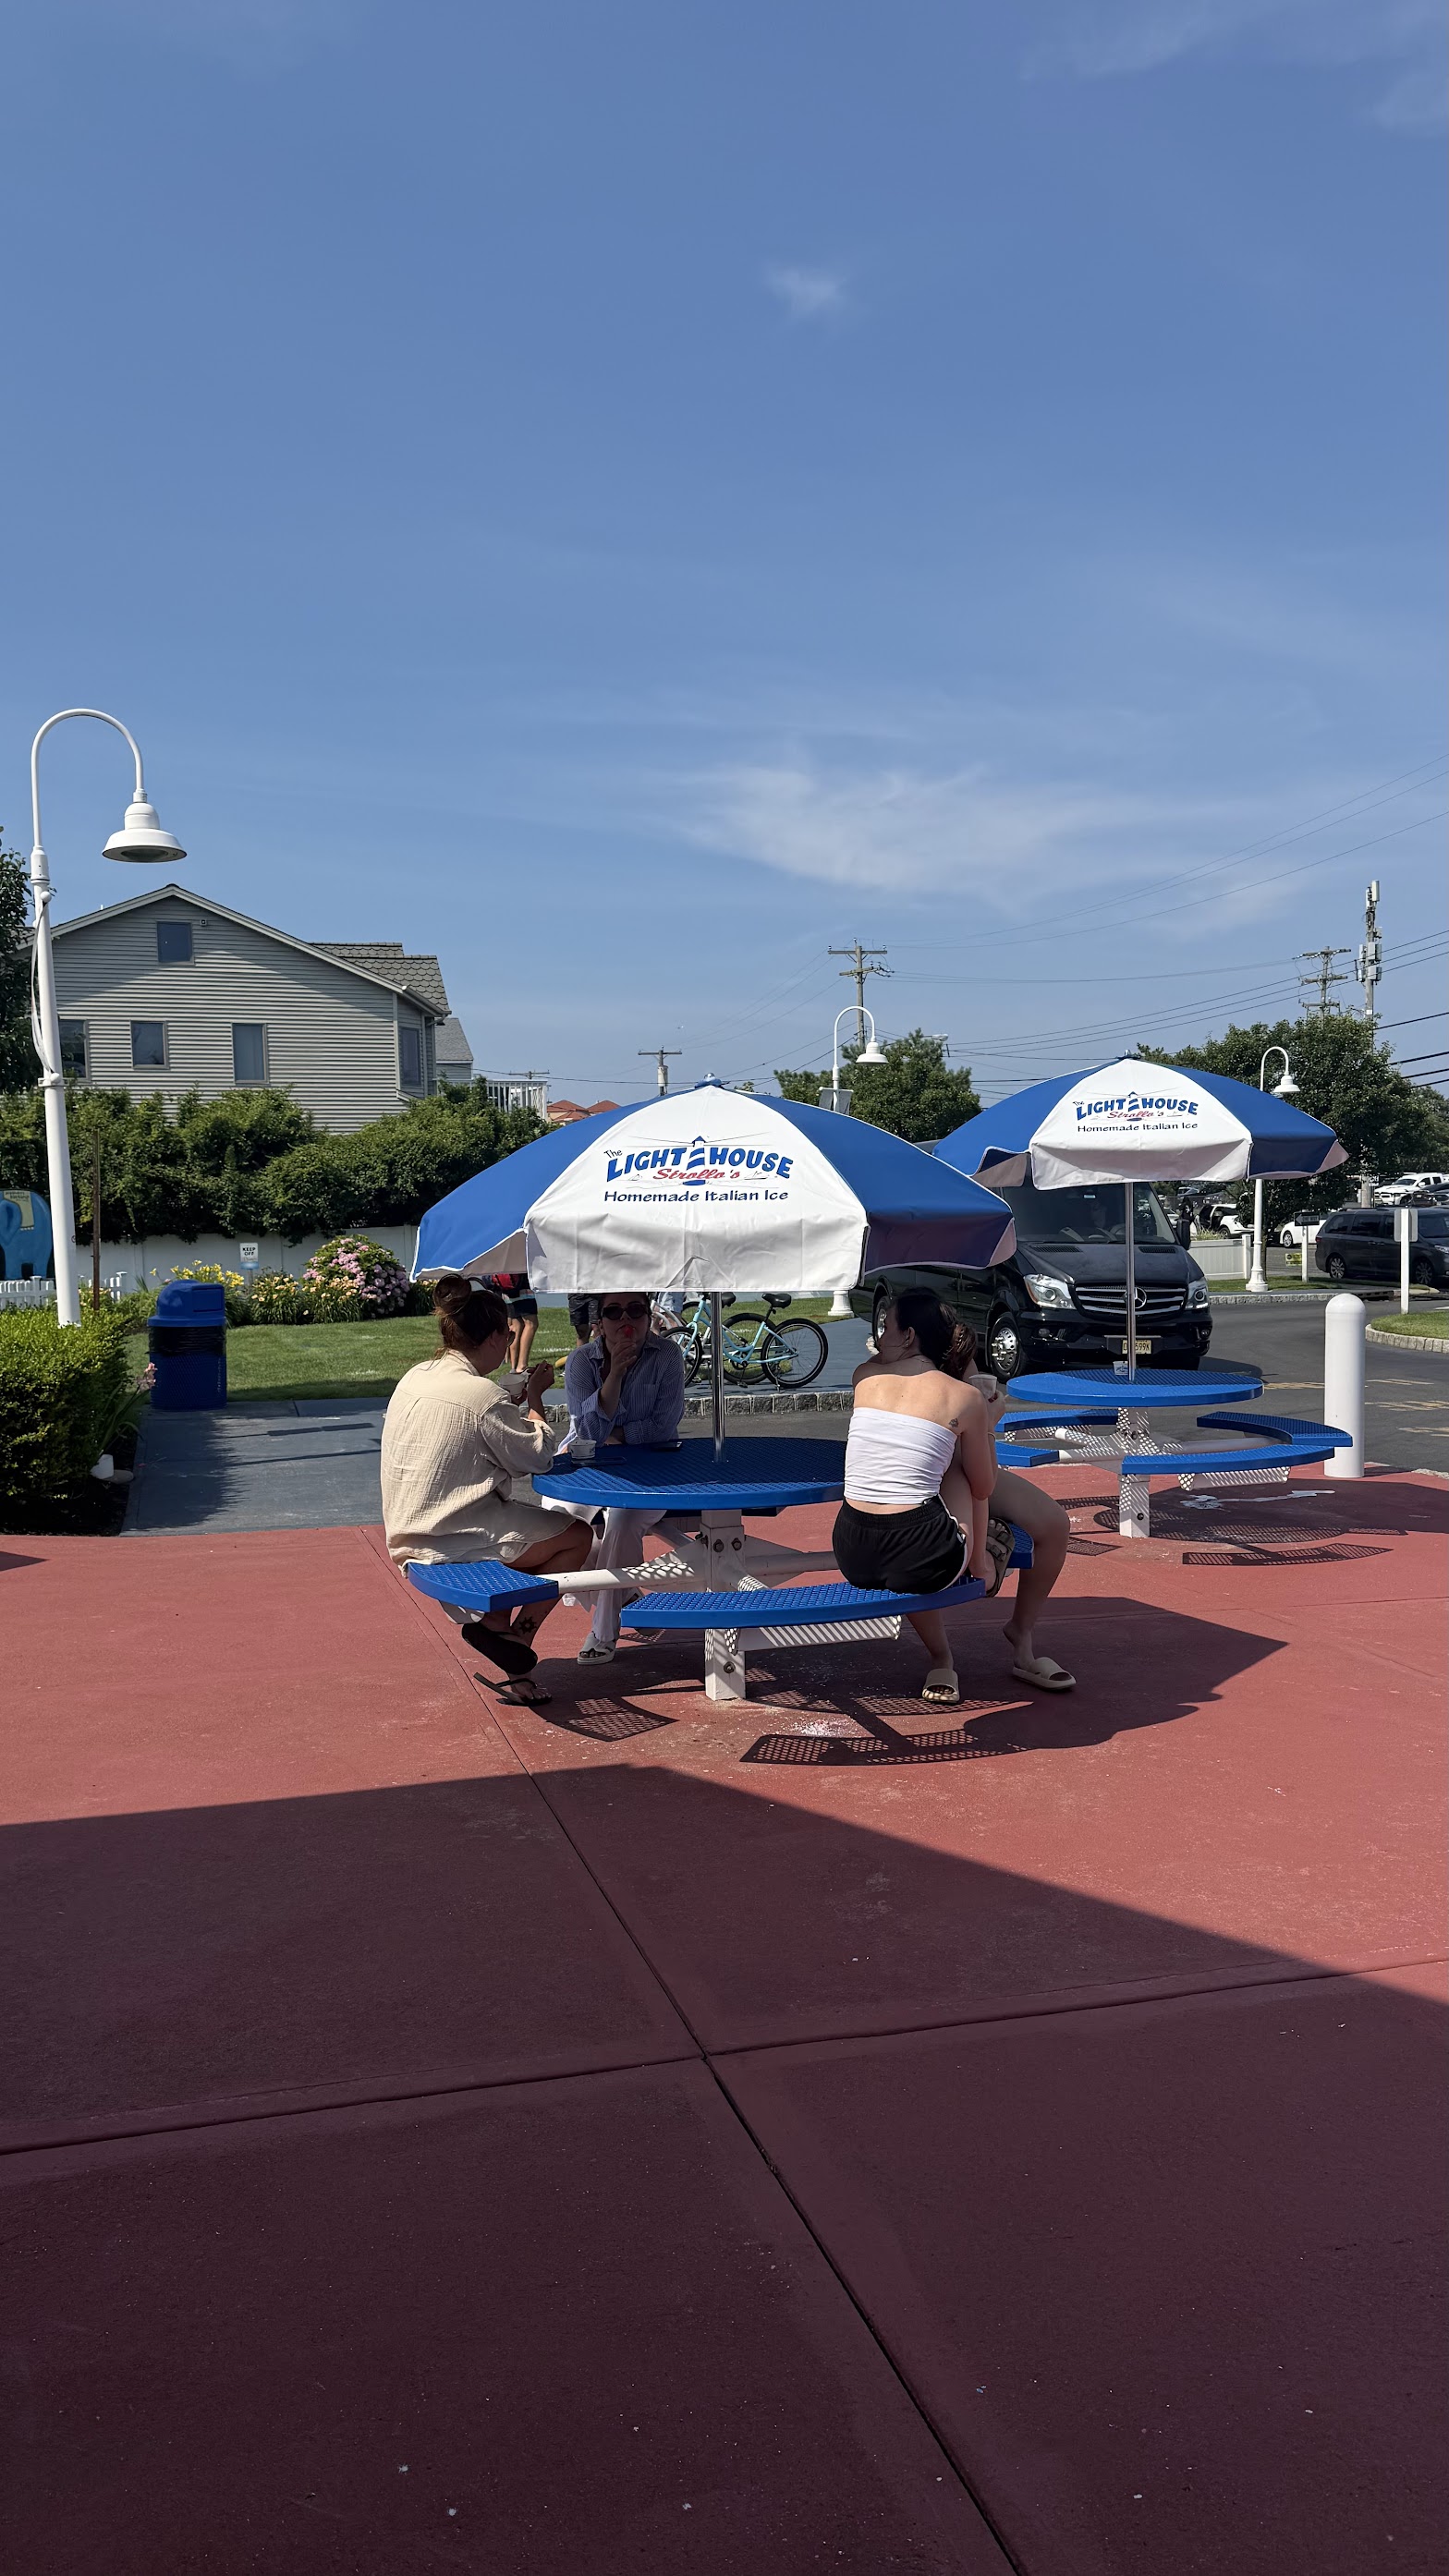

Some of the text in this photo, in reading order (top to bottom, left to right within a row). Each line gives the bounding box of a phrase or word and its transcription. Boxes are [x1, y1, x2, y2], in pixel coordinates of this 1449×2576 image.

[603, 1149, 623, 1159] The
[652, 1168, 740, 1180] Strollo's
[603, 1189, 789, 1202] Homemade Italian Ice
